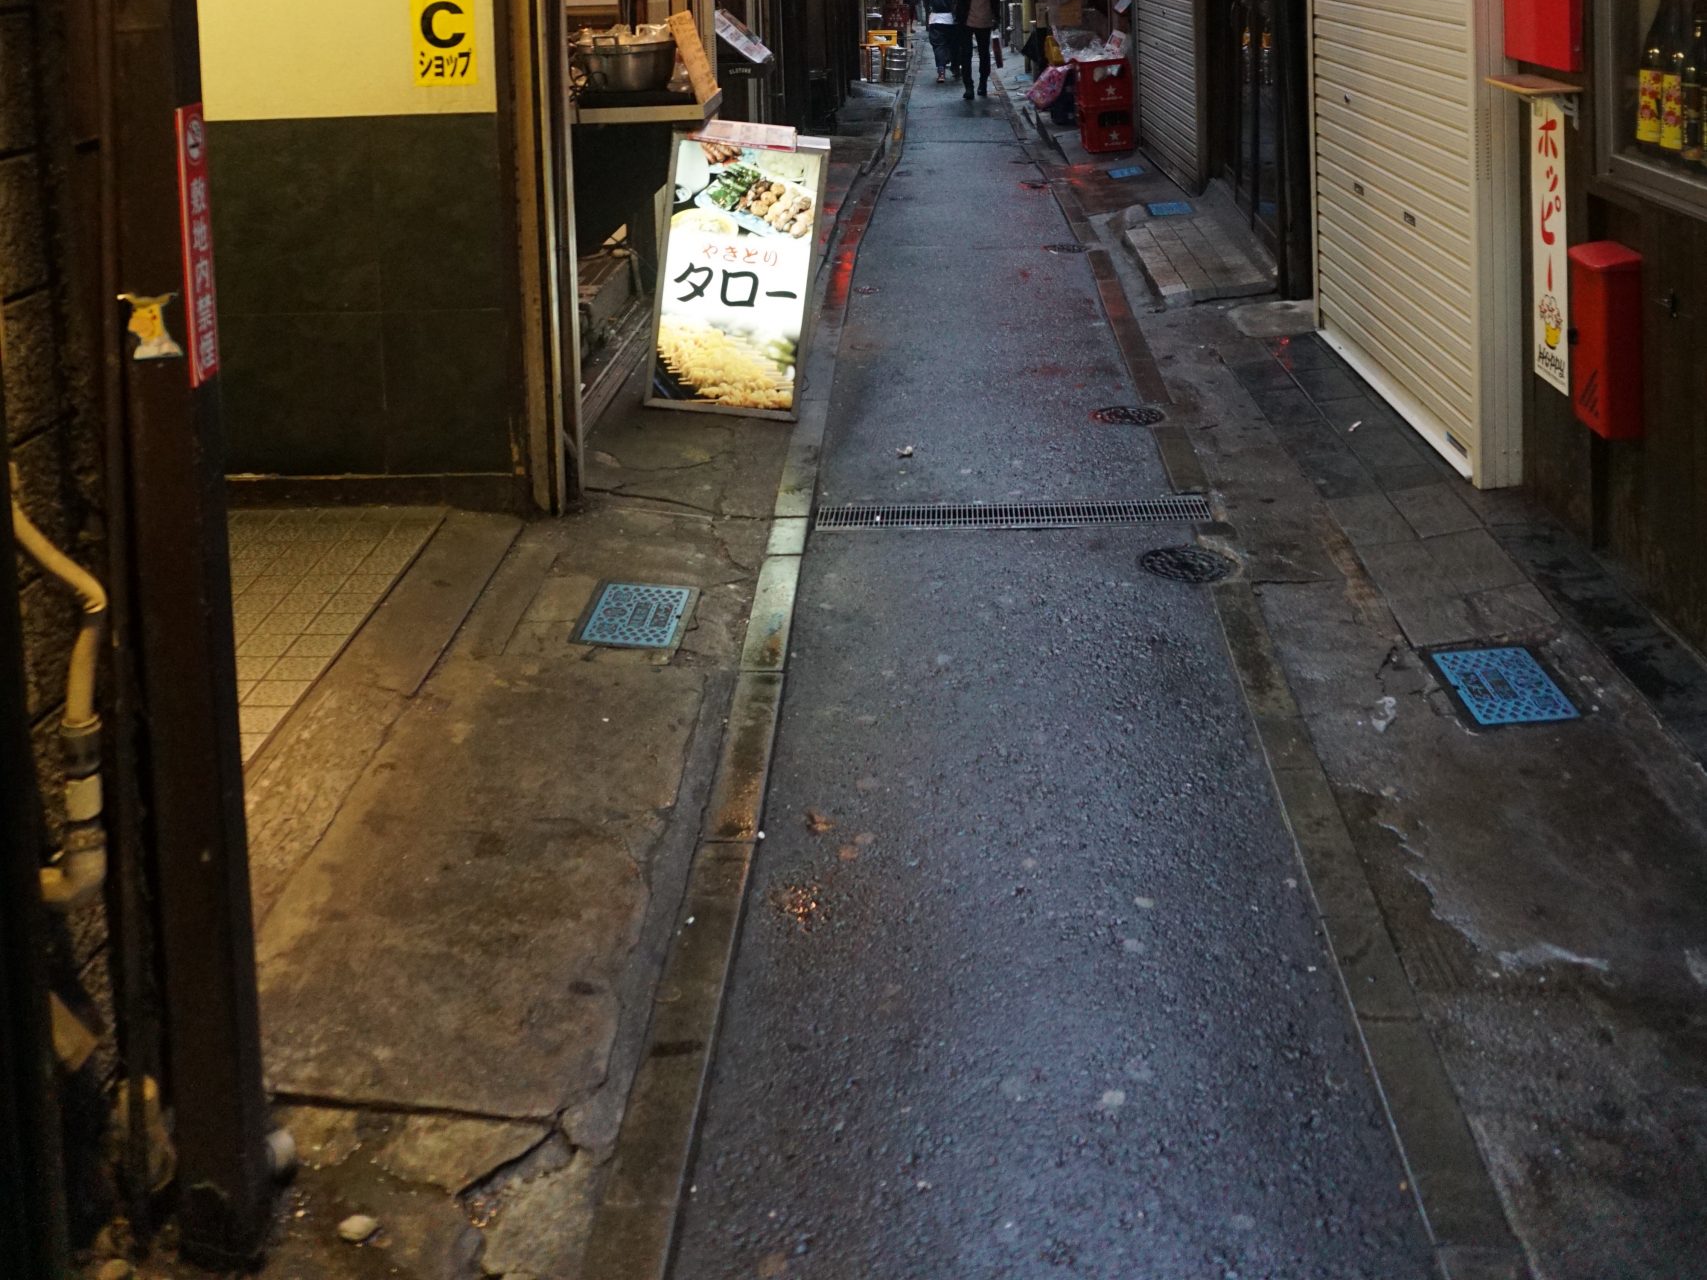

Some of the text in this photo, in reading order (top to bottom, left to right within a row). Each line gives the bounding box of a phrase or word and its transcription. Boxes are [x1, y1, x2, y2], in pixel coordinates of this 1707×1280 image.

[419, 49, 472, 79] ショップ
[1537, 116, 1562, 293] ホッピー
[702, 244, 778, 267] やきとり
[674, 262, 798, 308] タロー
